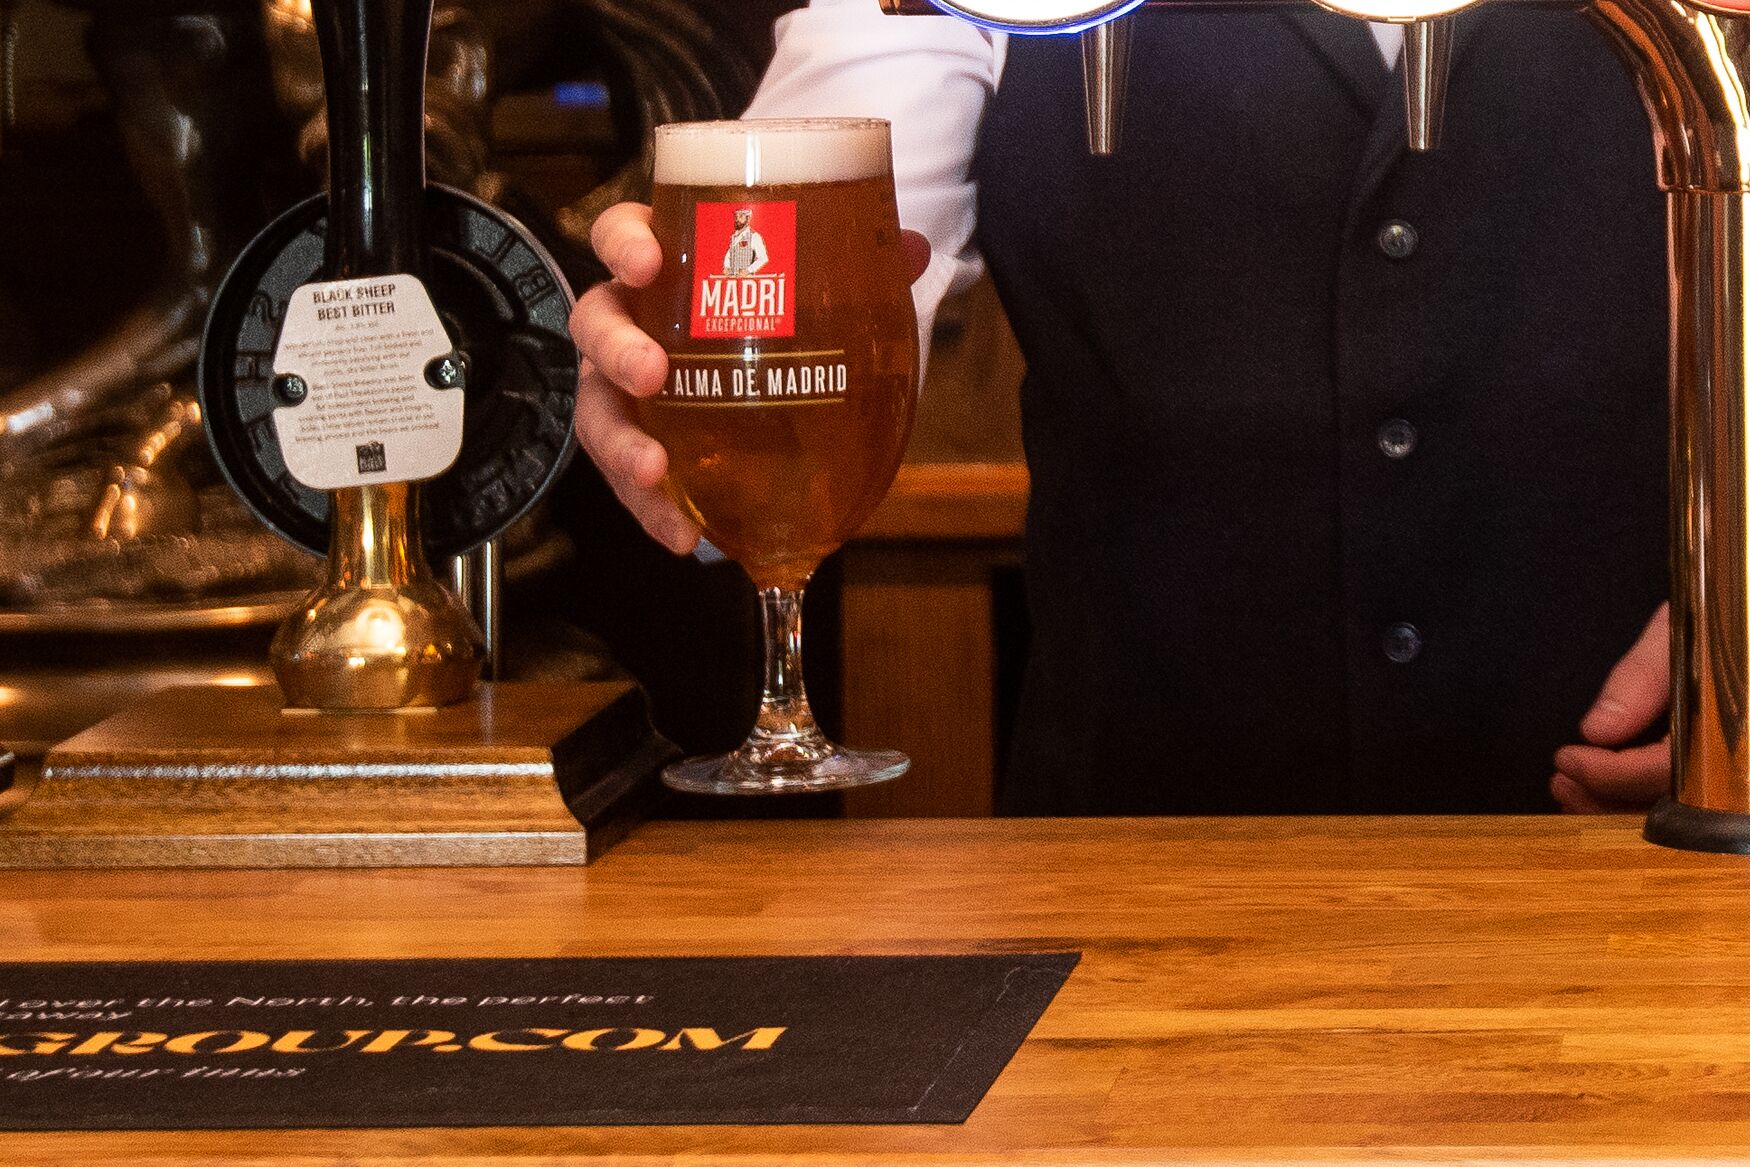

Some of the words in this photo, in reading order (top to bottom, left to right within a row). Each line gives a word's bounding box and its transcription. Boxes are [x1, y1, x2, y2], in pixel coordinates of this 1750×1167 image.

[313, 288, 353, 303] BLACK
[356, 284, 396, 299] SHEEP
[700, 273, 786, 317] MADRÍ
[317, 307, 347, 321] BEST
[353, 302, 396, 317] BITTER
[705, 317, 776, 332] EXCEPCIONAL
[675, 368, 723, 396] ALMA
[733, 368, 757, 396] DE
[768, 364, 847, 395] MADRID
[19, 998, 125, 1009] over
[137, 997, 213, 1007] the
[225, 995, 374, 1007] North,
[391, 995, 468, 1006] the
[476, 993, 656, 1007] perfect
